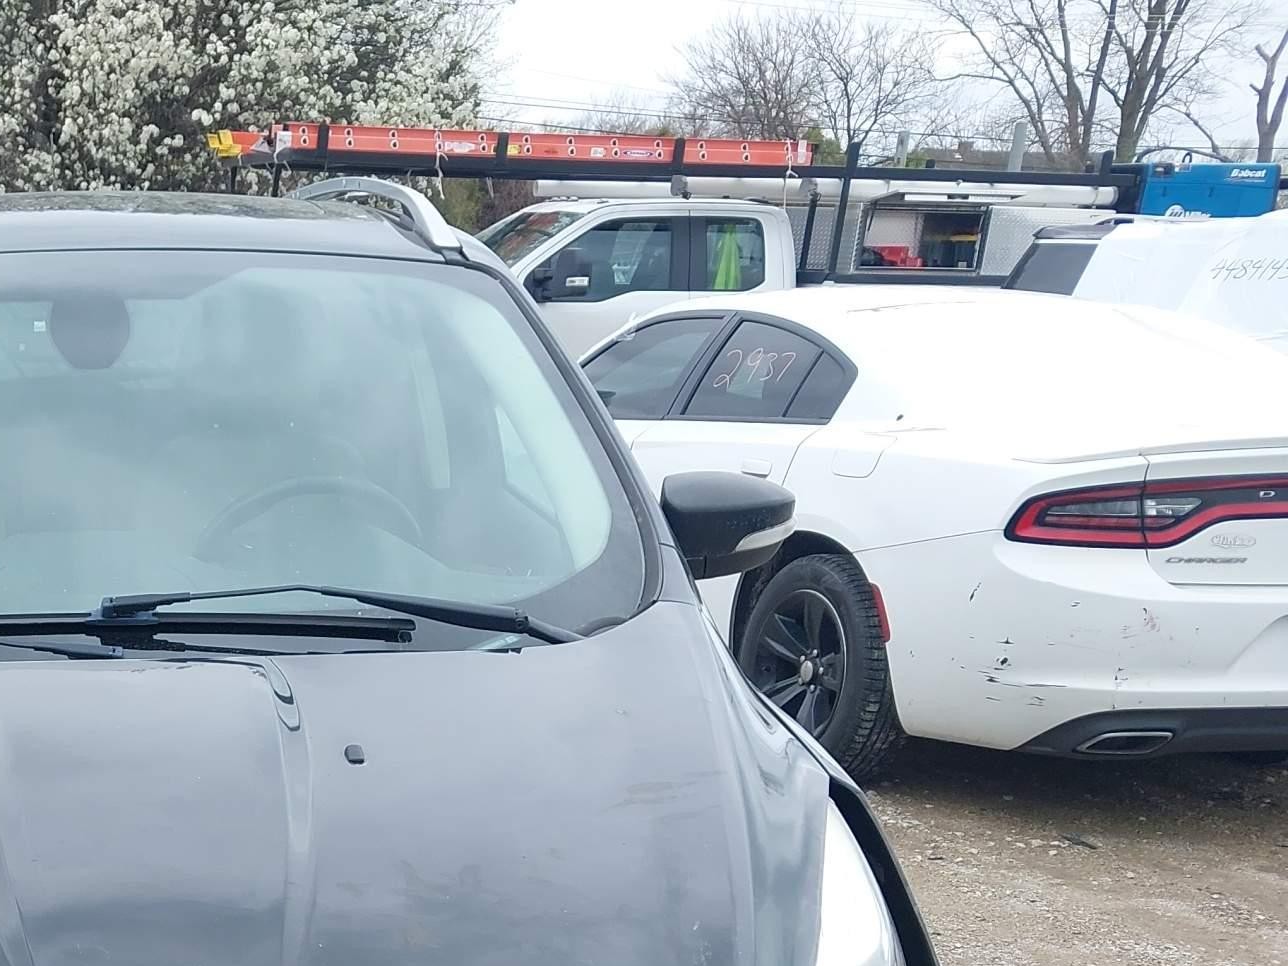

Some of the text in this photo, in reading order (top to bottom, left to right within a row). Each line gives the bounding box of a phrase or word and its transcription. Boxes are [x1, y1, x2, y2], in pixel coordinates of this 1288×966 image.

[1230, 168, 1267, 178] Bobcat
[712, 347, 797, 389] 2937
[1165, 556, 1249, 564] CHARGER
